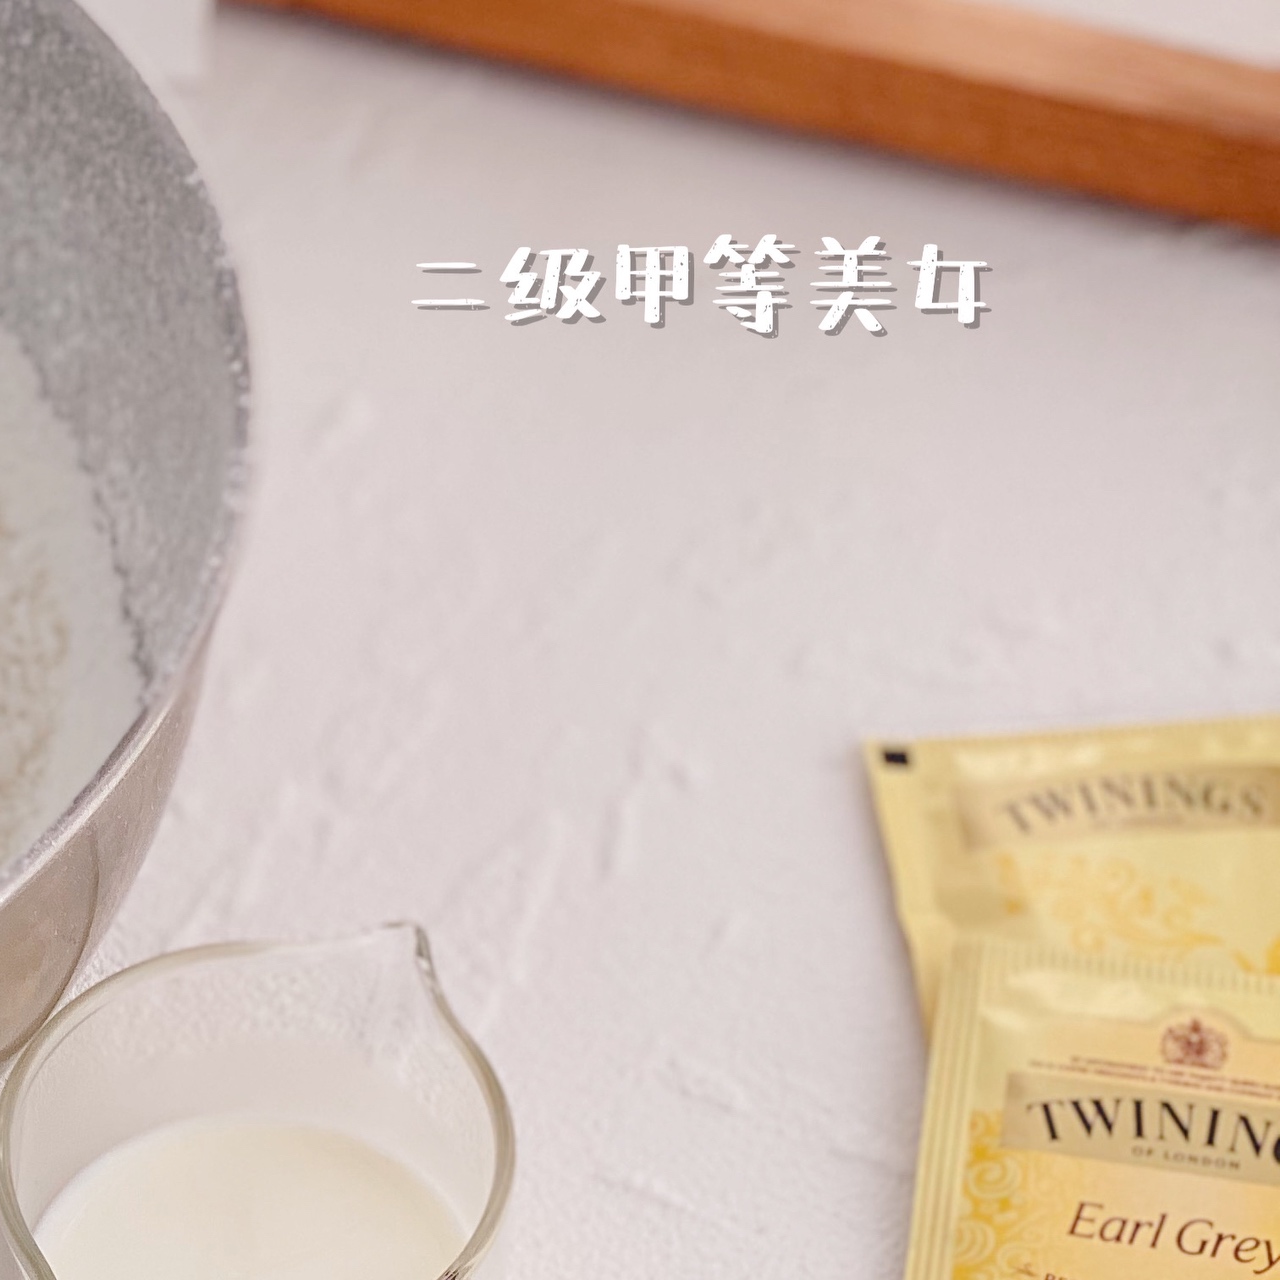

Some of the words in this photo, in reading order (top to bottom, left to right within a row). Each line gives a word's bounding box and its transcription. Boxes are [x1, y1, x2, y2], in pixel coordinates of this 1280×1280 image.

[1003, 776, 1266, 834] TWININGS
[1025, 1097, 1280, 1166] TWININ
[1067, 1201, 1167, 1250] Earl
[1176, 1218, 1280, 1275] Grey
